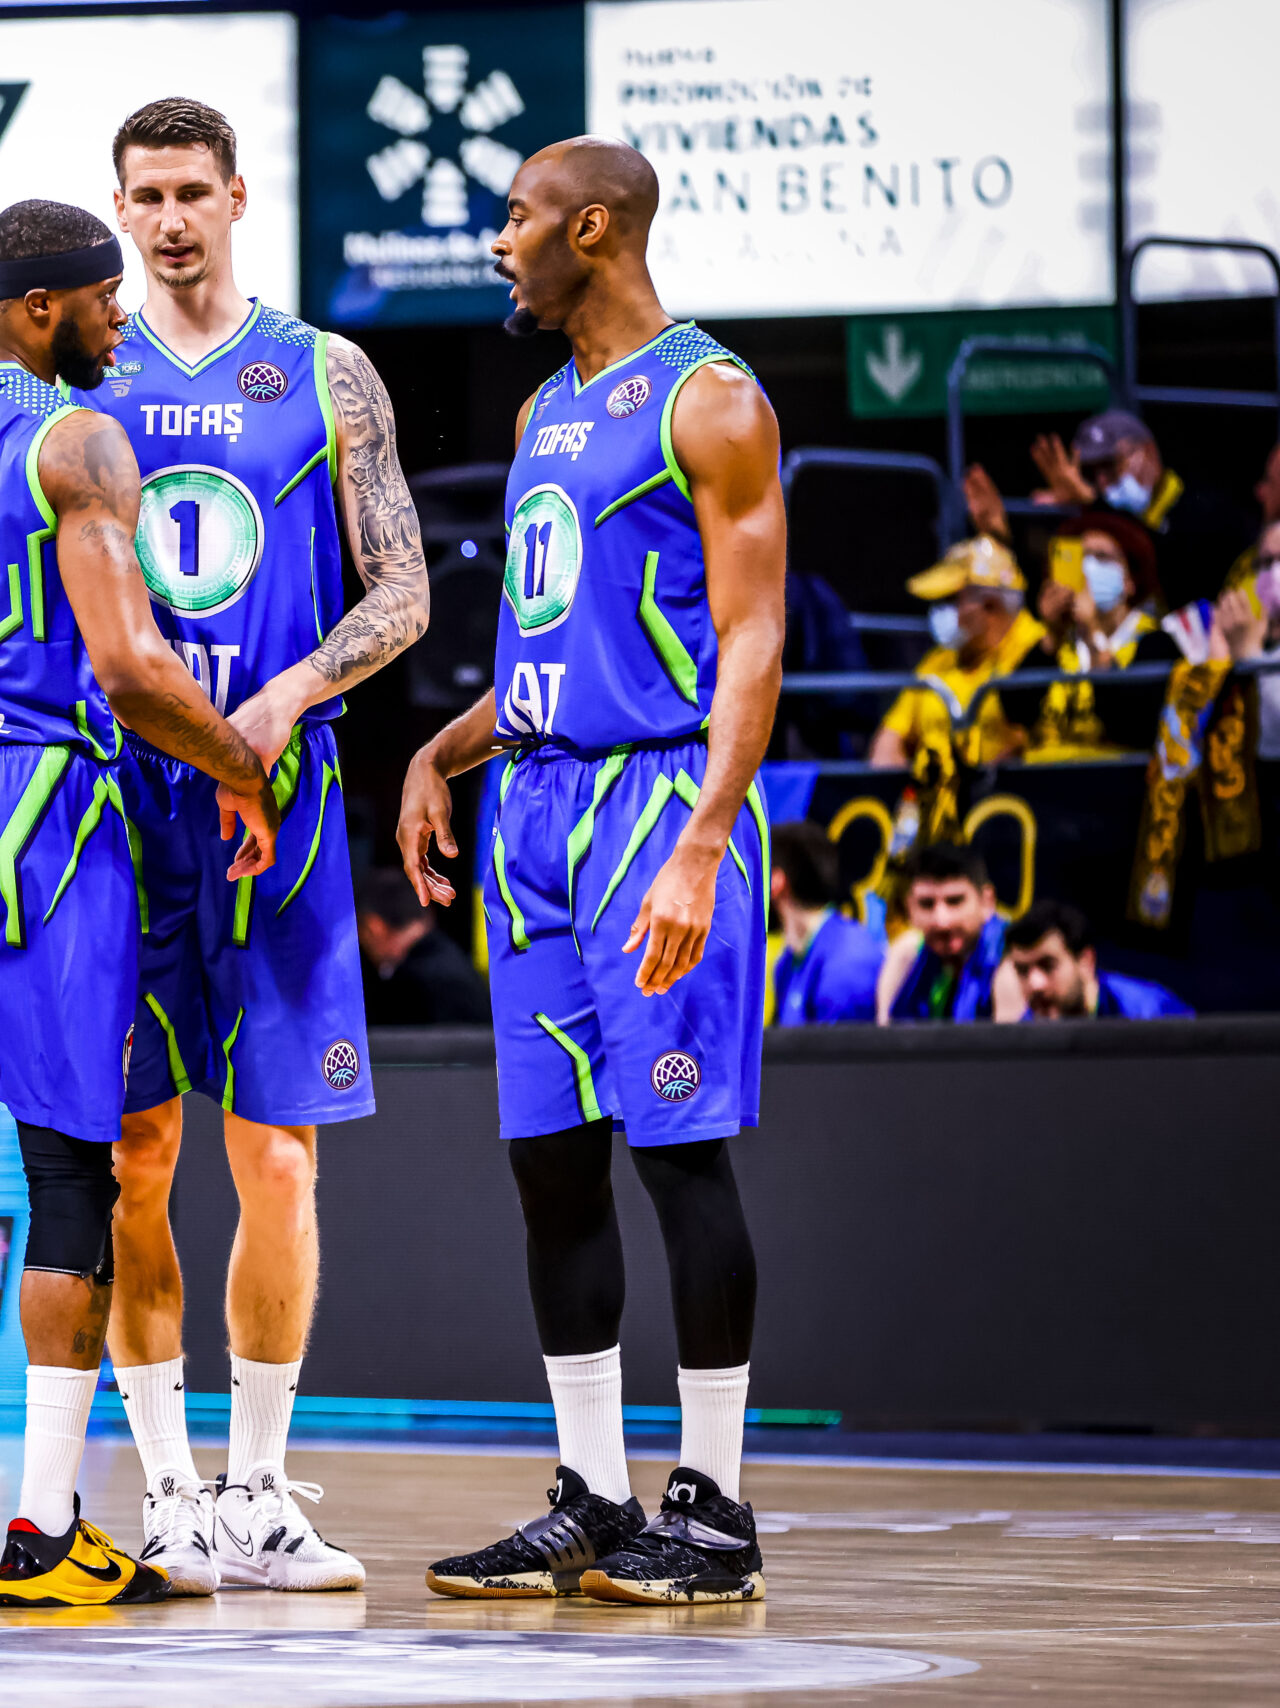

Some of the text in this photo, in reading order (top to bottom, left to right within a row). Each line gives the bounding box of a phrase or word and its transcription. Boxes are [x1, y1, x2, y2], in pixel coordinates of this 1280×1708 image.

[622, 111, 880, 154] VIVIENDAS
[666, 153, 1014, 215] AN BENITO
[140, 403, 244, 443] TOFAŞ
[529, 421, 596, 461] TOFAŞ
[169, 500, 200, 576] 1
[523, 521, 553, 599] 11
